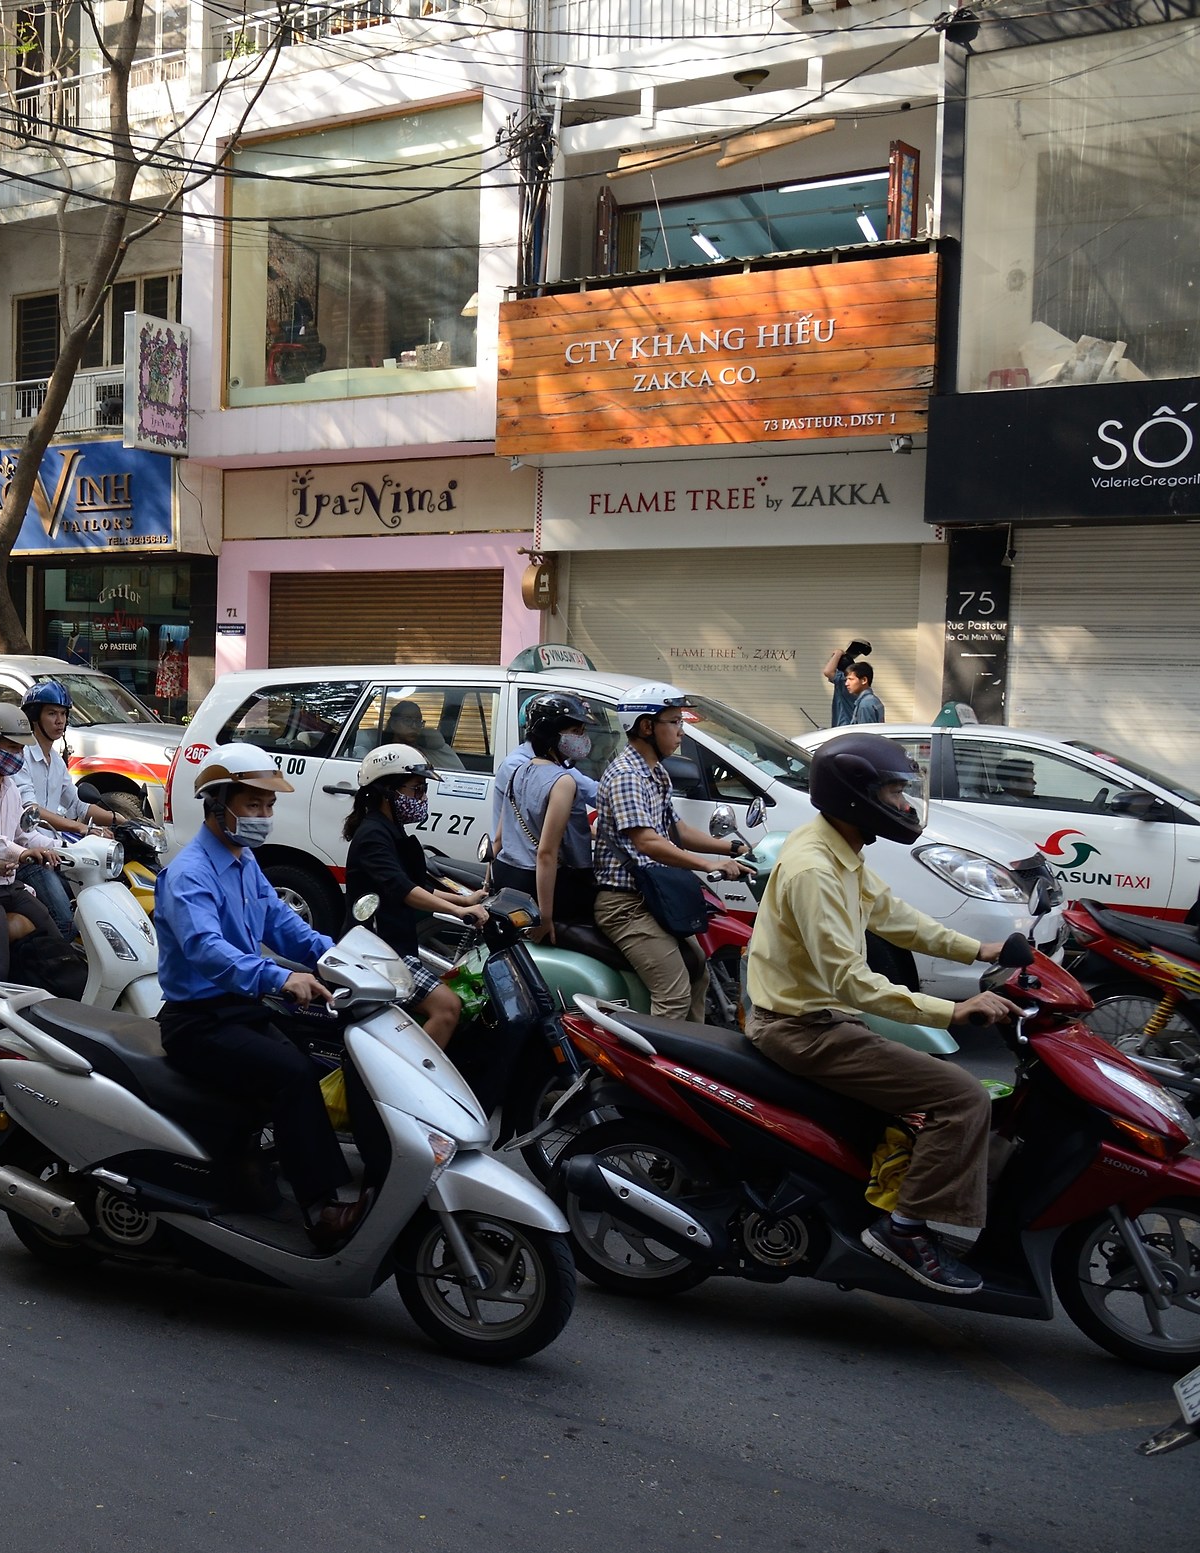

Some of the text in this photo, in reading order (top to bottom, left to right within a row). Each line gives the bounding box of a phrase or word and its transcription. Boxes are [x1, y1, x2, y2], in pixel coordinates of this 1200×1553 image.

[565, 313, 837, 365] CTY KHANG HIẾU
[633, 366, 761, 393] ZAKKA CO.
[764, 413, 896, 431] 73 PASTEUR, DIST 1
[1091, 473, 1200, 488] ValerieGregori
[291, 469, 458, 529] Ipa-Nima
[589, 482, 890, 515] FLAME TREE by ZAKKA
[62, 516, 133, 533] TAILORS
[99, 583, 142, 605] Tailor
[226, 608, 237, 617] 71
[959, 592, 995, 615] 75
[947, 620, 1007, 630] Rue Pasteur
[957, 633, 969, 641] Chi
[971, 633, 989, 641] Minh
[99, 643, 137, 651] 69 PASTEUR
[670, 648, 705, 657] FLAME
[709, 648, 736, 658] TREE
[753, 649, 797, 661] ZAKKA
[286, 757, 306, 775] 00
[416, 812, 475, 836] 27 27
[1055, 871, 1150, 889] ASUN TAXI
[1102, 1157, 1148, 1177] HONDA
